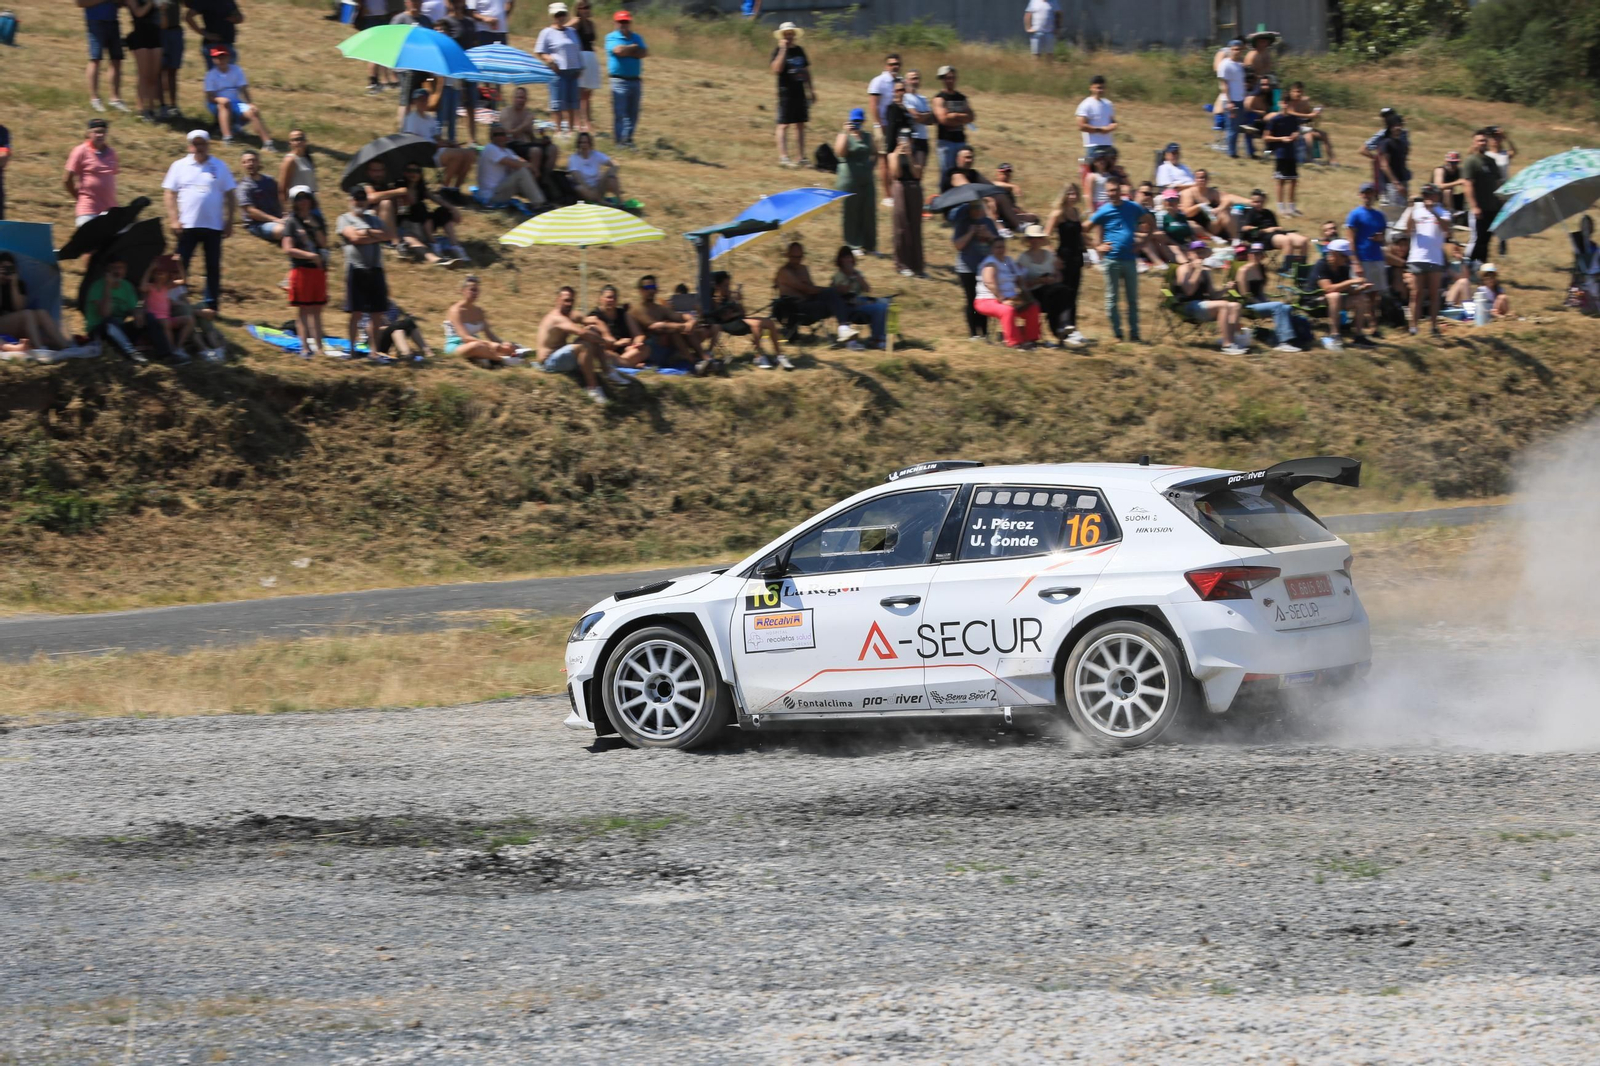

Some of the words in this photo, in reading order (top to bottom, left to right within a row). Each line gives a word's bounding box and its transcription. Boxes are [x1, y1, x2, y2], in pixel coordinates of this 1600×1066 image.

[899, 463, 938, 477] MICHELIN
[972, 518, 987, 530] J.
[990, 517, 1035, 530] Pérez
[1125, 514, 1151, 522] SUOMI
[1066, 513, 1102, 547] 16
[970, 534, 986, 547] U.
[990, 533, 1039, 547] Conde
[751, 584, 780, 608] 16
[784, 585, 804, 597] La
[763, 615, 794, 627] Recalvi
[796, 633, 812, 641] salud
[858, 617, 1043, 661] A-SECUR
[797, 699, 854, 708] Fontalclima
[863, 693, 923, 708] pro-driver
